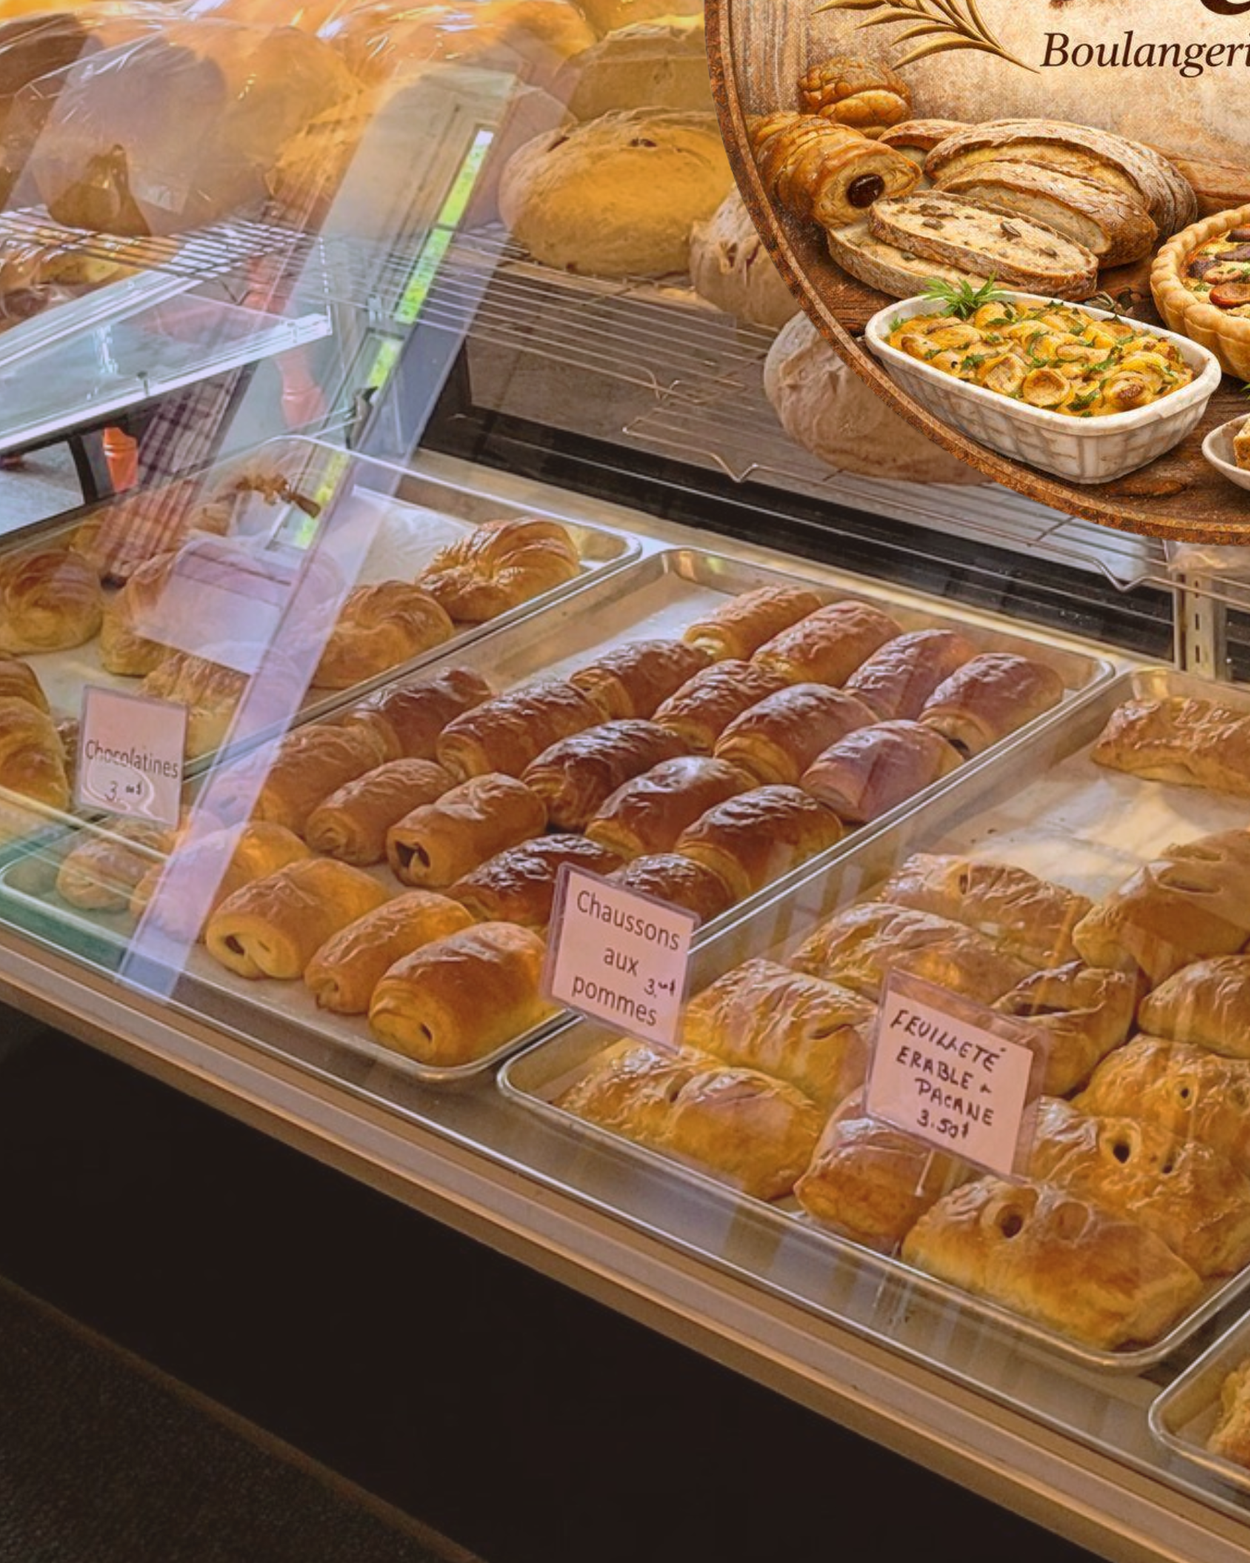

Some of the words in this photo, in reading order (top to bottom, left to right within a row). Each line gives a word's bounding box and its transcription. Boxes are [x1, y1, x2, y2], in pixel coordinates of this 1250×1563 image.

[85, 740, 178, 779] Chocolatines
[576, 890, 680, 951] Chaussons
[603, 947, 639, 977] aux
[571, 976, 658, 1027] pommes
[896, 1045, 974, 1090] ERABLE
[914, 1078, 994, 1126] PACANE
[916, 1109, 969, 1139] 3.50$
